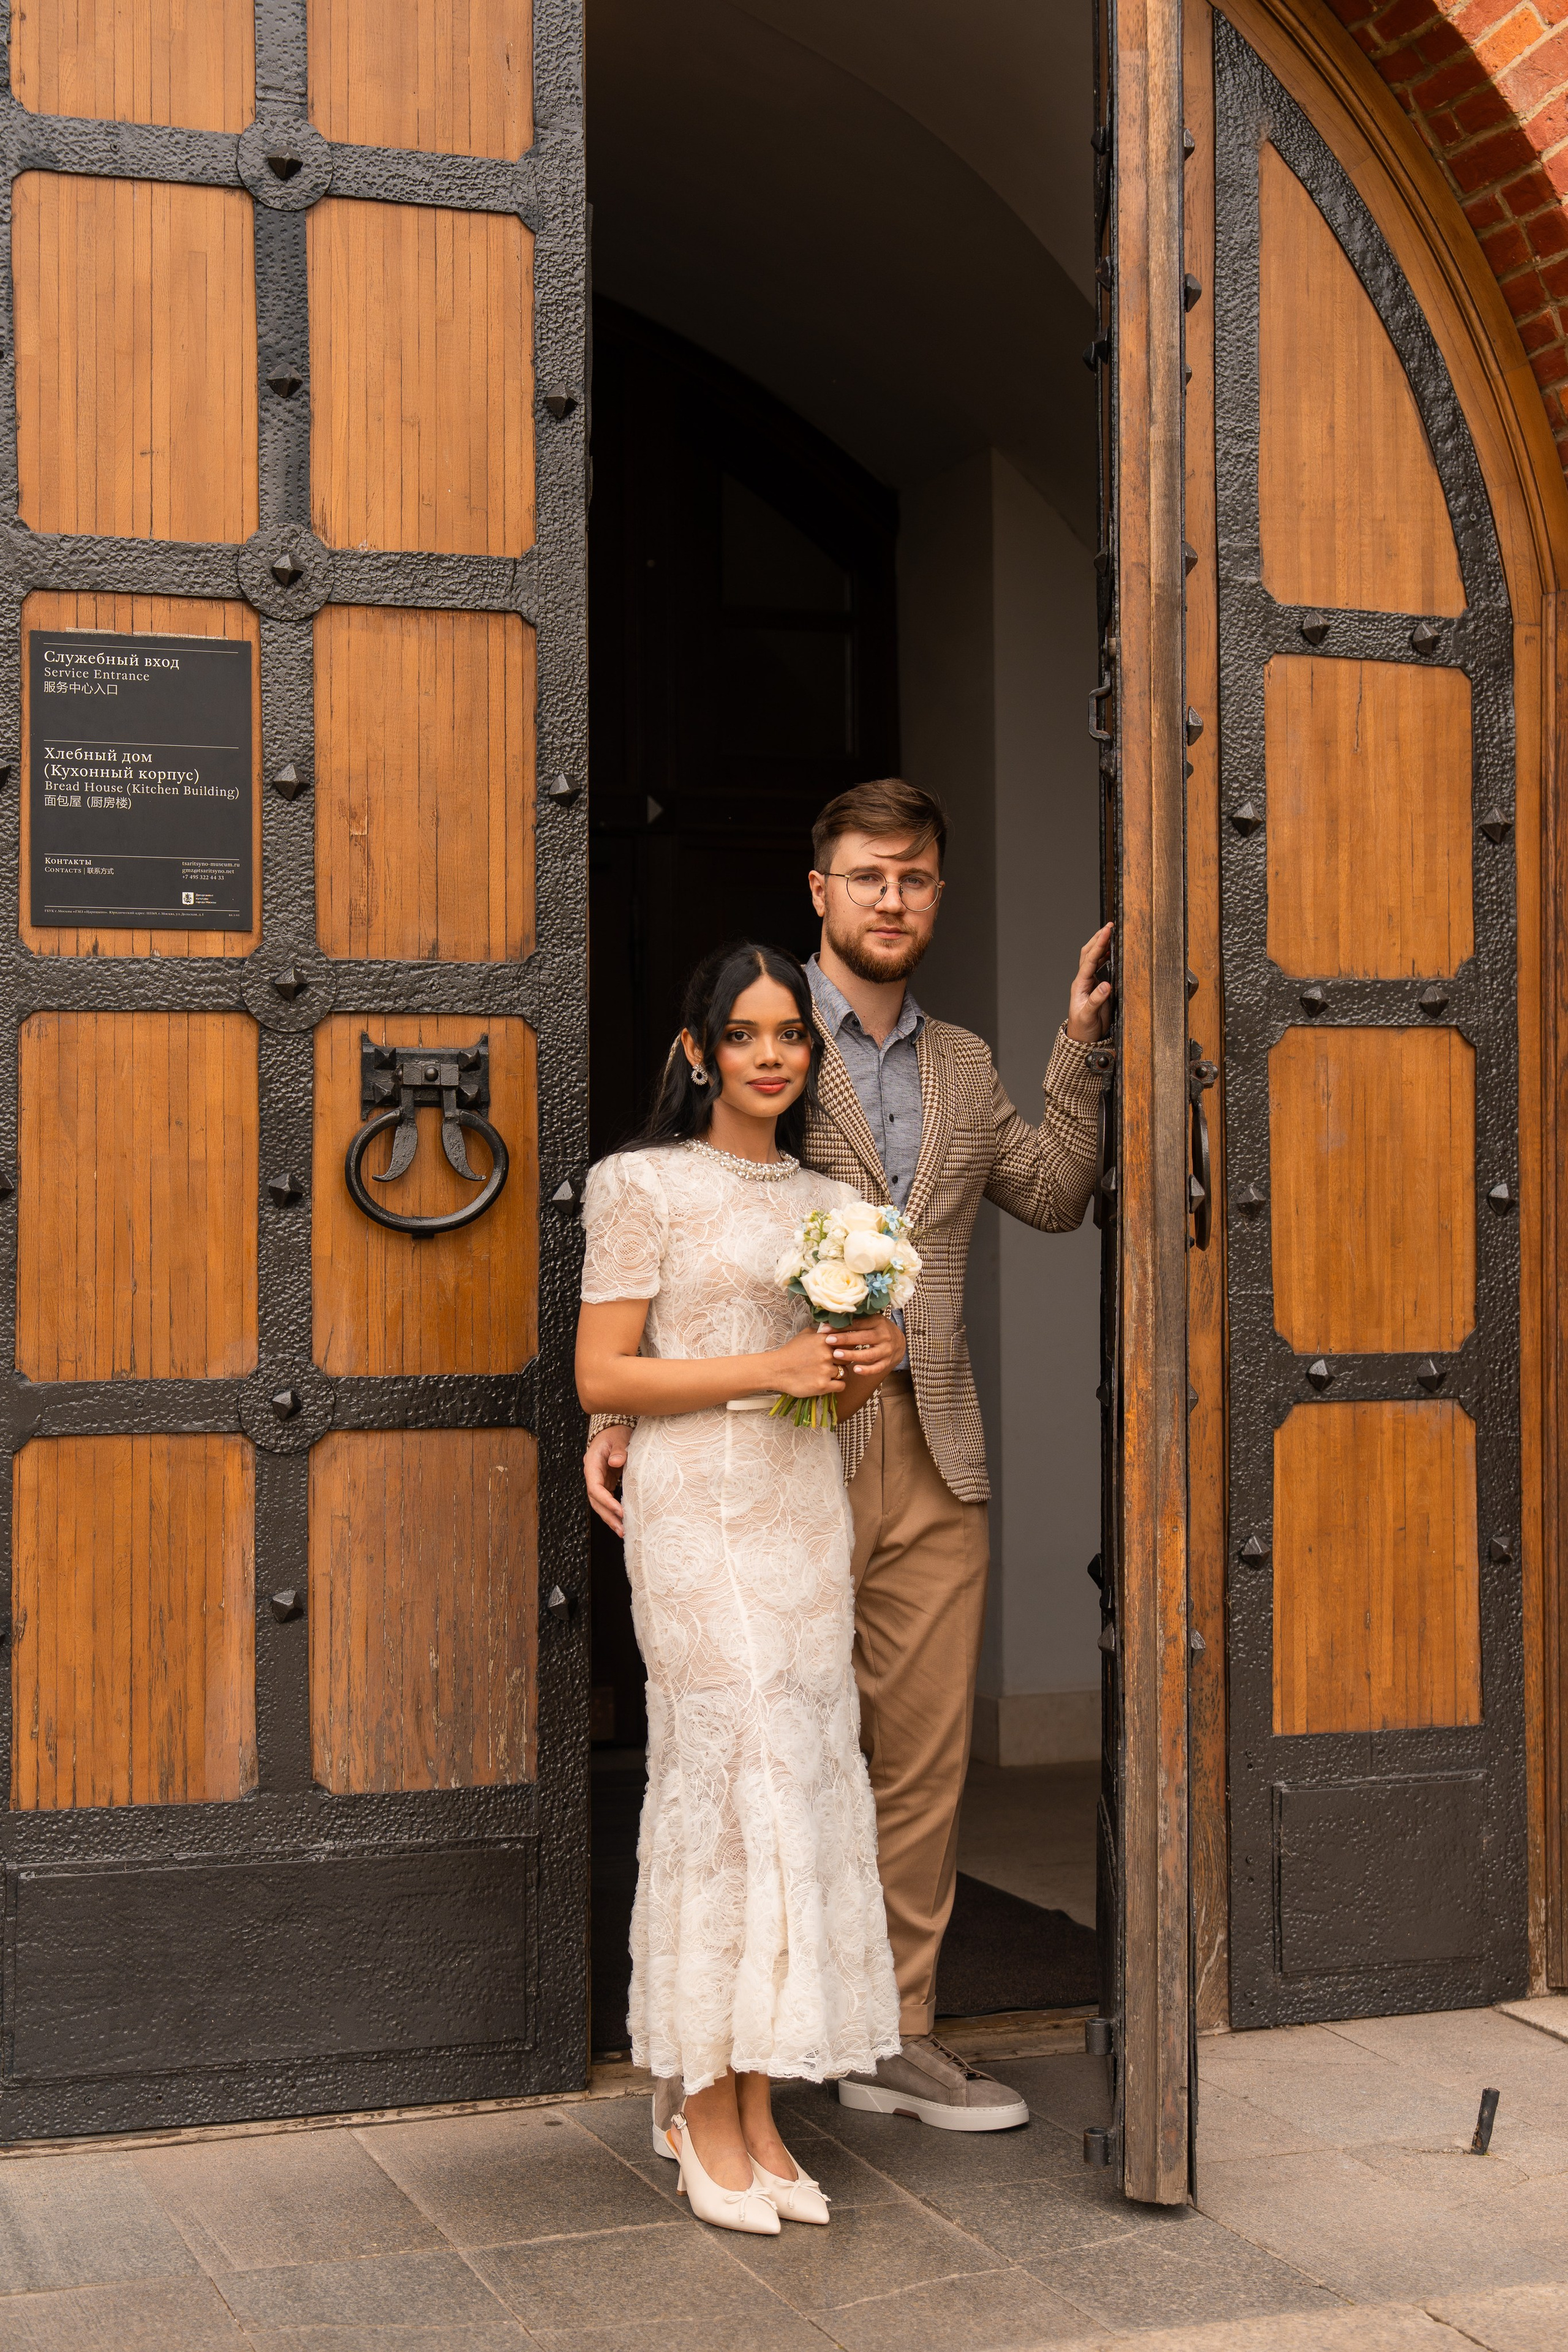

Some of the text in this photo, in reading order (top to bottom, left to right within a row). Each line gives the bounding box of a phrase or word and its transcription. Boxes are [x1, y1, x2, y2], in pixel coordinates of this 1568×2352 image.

[44, 650, 179, 670] Служебный вход
[44, 667, 149, 681] Service Entrance
[43, 681, 118, 695] 服务中心入口
[44, 747, 153, 764] Хлебный дом
[44, 763, 200, 784] (Кухонный корпус)
[45, 781, 239, 800] Bread House (Kitchen Building)
[44, 794, 132, 810] 面包屋 (厨房楼)
